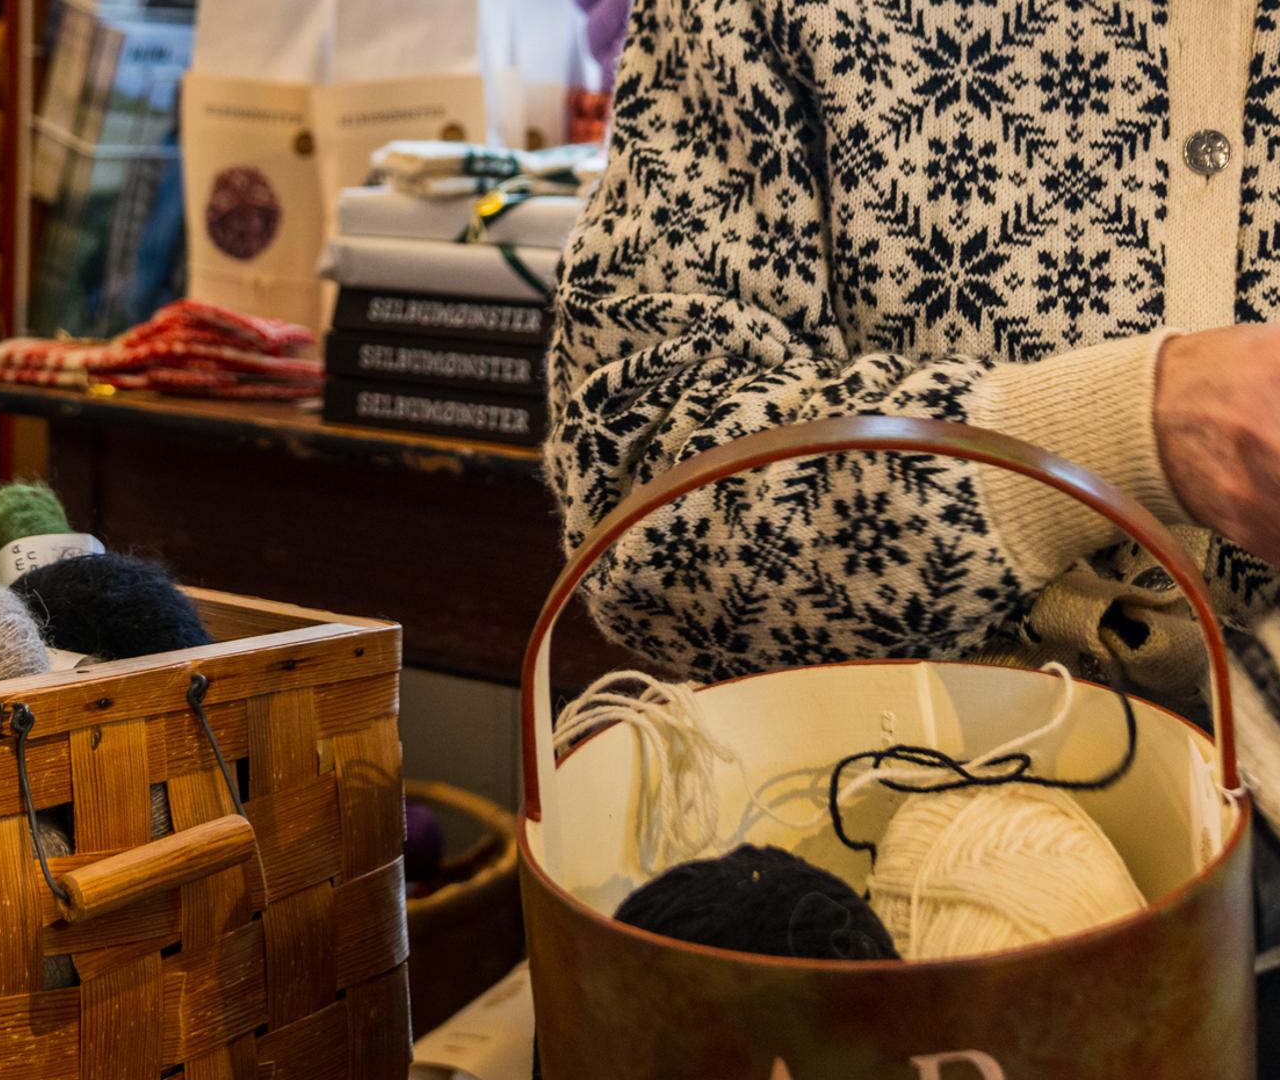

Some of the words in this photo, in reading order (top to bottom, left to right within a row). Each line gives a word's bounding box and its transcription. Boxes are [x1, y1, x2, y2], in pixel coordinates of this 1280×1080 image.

[368, 296, 543, 333] SELBUMØNSTER
[358, 344, 531, 383] SELBUMØNSTER
[357, 392, 530, 433] SELBUMØNSTER
